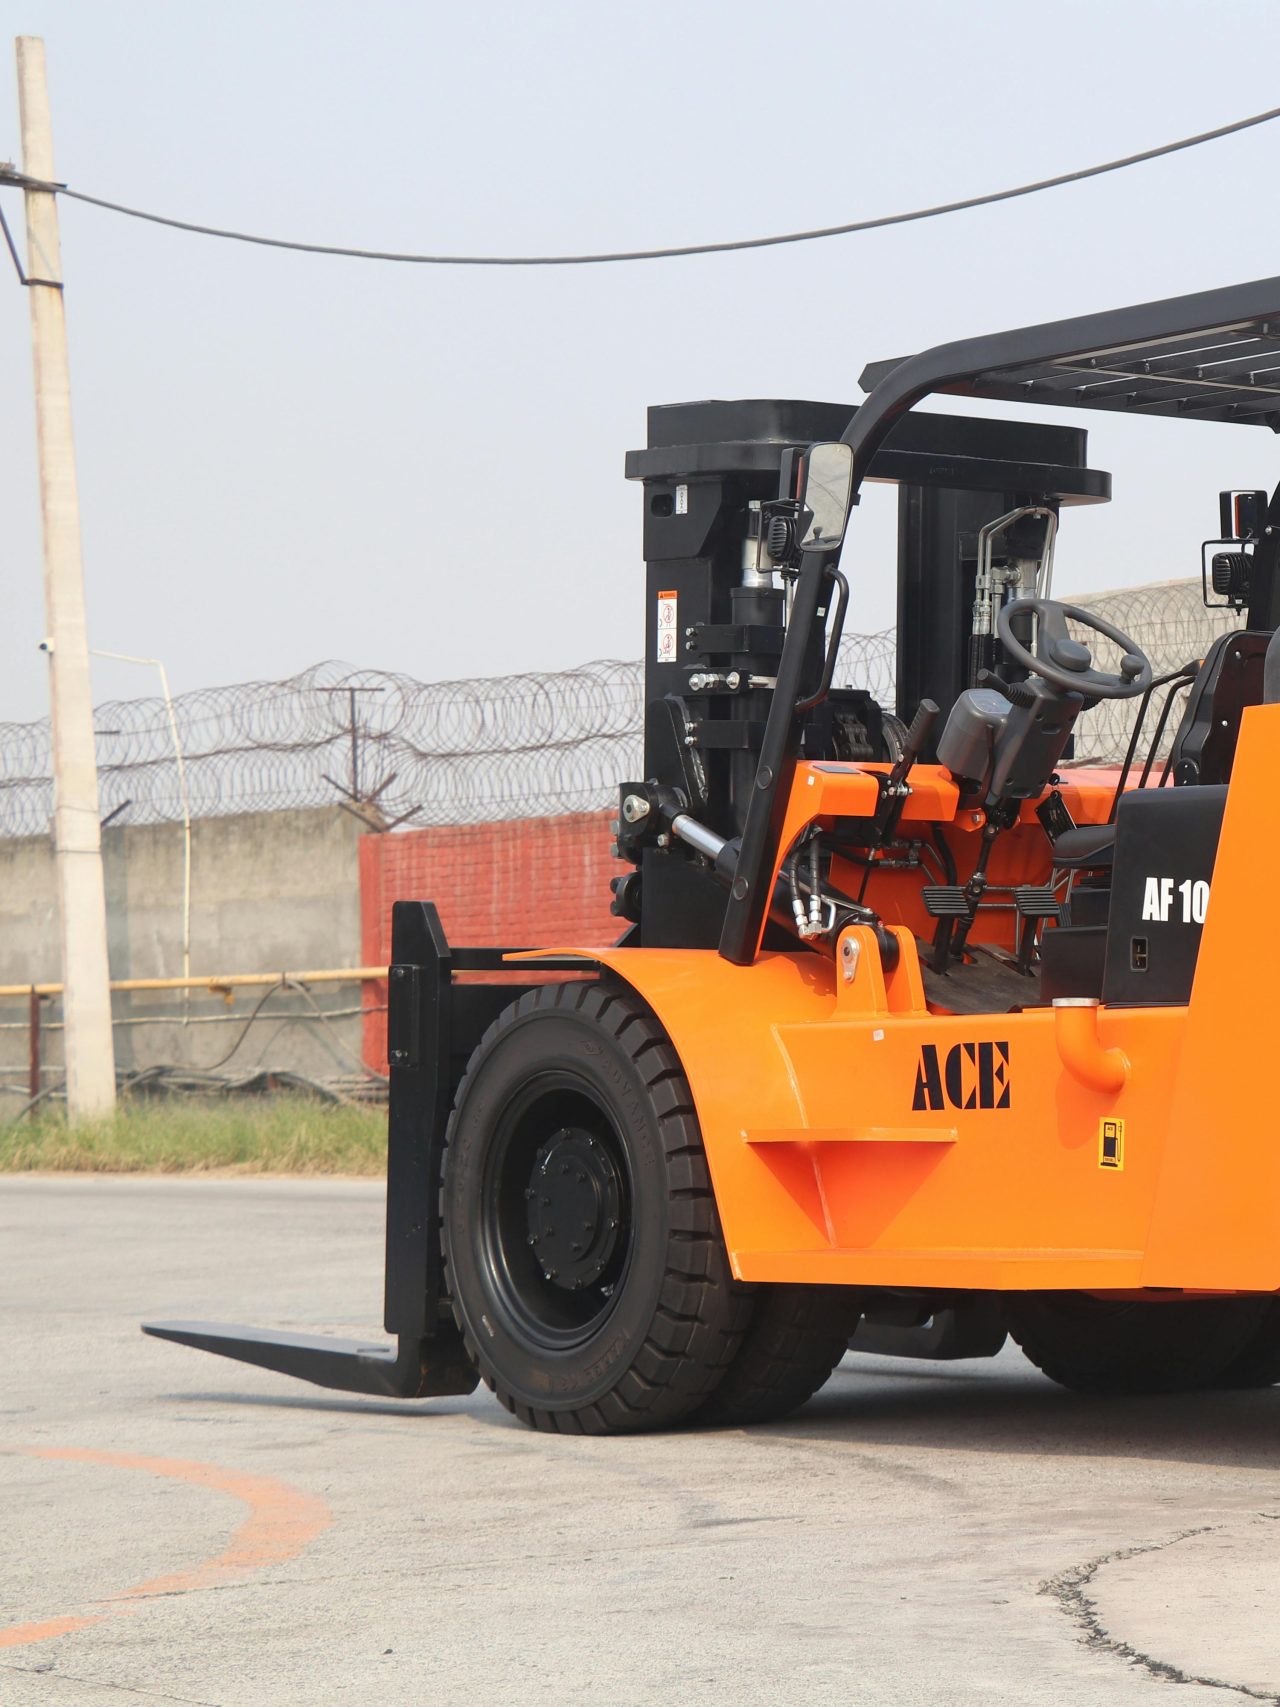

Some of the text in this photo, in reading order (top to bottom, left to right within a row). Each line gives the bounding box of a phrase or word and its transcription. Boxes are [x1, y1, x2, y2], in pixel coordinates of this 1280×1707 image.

[1142, 877, 1209, 923] AF 10
[912, 1041, 1010, 1111] ACE
